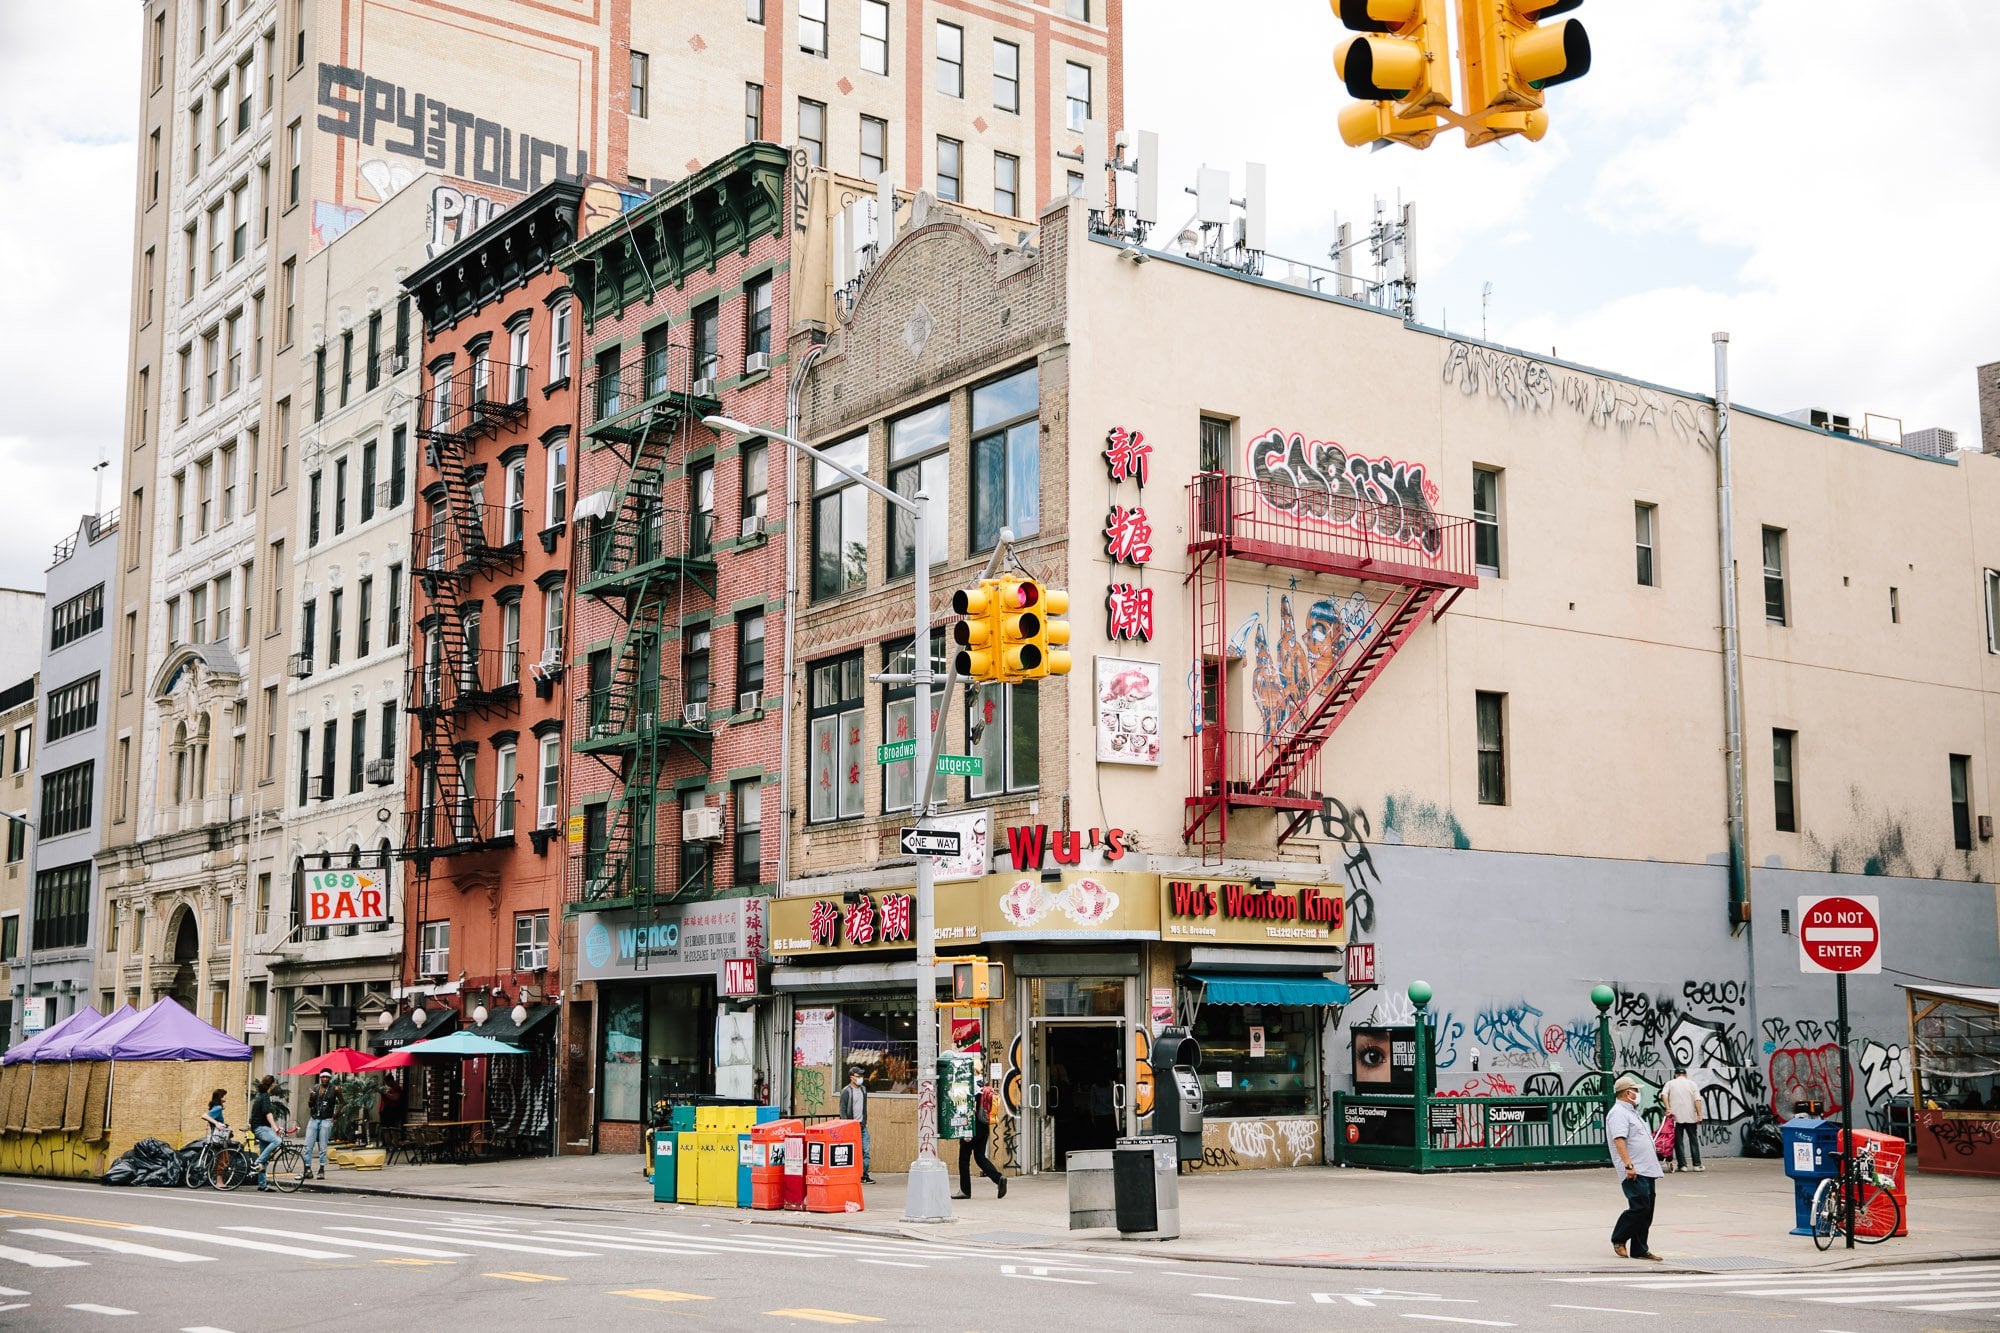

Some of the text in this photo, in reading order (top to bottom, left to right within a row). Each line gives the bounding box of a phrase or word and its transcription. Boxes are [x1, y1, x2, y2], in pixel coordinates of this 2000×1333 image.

[318, 62, 425, 159] SPY
[1103, 426, 1155, 643] 新糖潮
[878, 748, 882, 761] E
[936, 758, 971, 774] utgers
[908, 837, 956, 849] ONE WAY
[312, 872, 355, 891] 169
[310, 890, 383, 920] BAR
[1171, 881, 1344, 929] Wu's Wonton King
[809, 893, 911, 947] 新糖潮
[1814, 911, 1864, 924] DO NOT
[1190, 926, 1217, 937] Broadway
[1818, 944, 1862, 958] ENTER
[1348, 945, 1365, 983] ATM
[725, 962, 744, 994] ATM
[744, 979, 754, 993] HRS
[1166, 1027, 1185, 1035] ATM
[393, 1038, 404, 1046] BAR
[1345, 1106, 1388, 1118] East Broadway
[1489, 1109, 1525, 1122] Subway
[1345, 1115, 1366, 1124] Station
[1349, 1128, 1356, 1139] F
